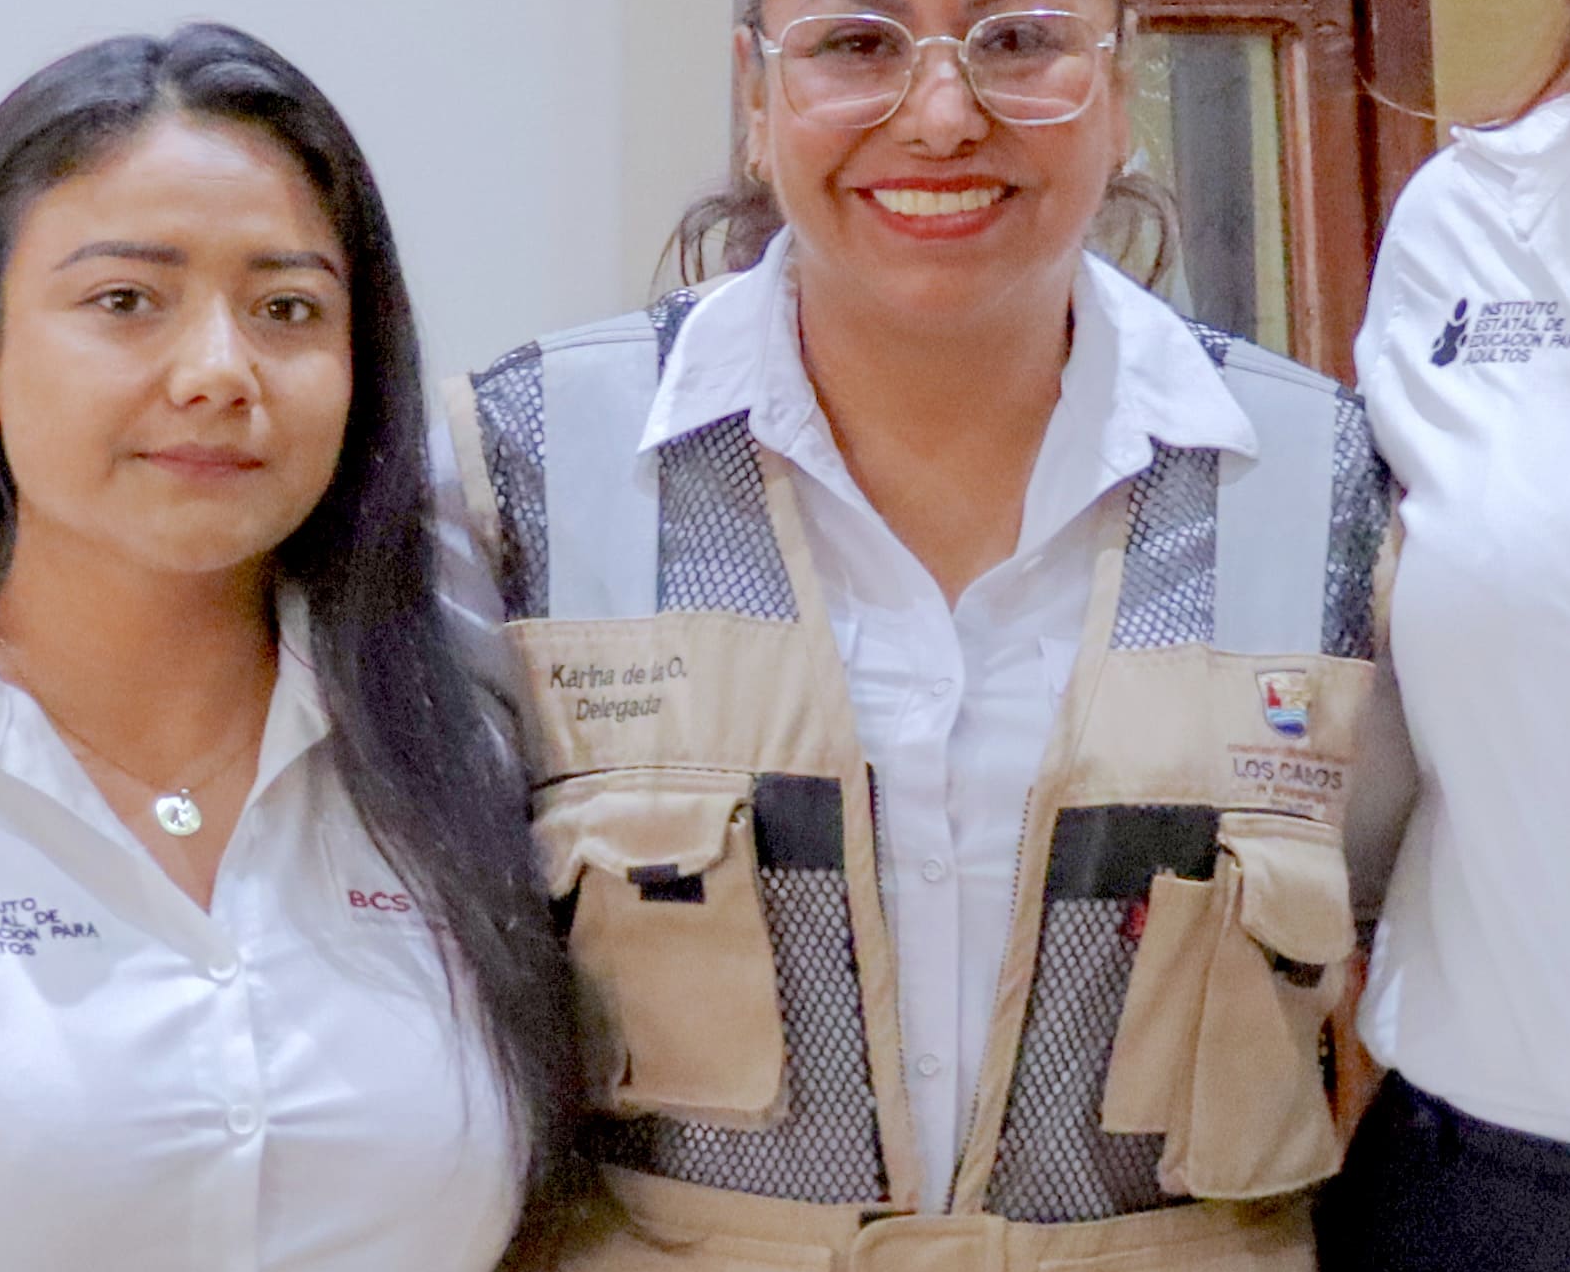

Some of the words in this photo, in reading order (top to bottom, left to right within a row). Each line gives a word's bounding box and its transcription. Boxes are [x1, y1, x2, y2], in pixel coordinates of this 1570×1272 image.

[1481, 301, 1558, 317] INSTITUTO
[1474, 318, 1538, 332] ESTATAL
[1544, 318, 1565, 331] DE
[1463, 349, 1531, 365] ADULTOS
[550, 664, 615, 689] Karina
[622, 663, 645, 685] de
[651, 662, 664, 684] la
[576, 693, 662, 722] Delegada
[1233, 757, 1274, 781] LOS
[34, 909, 61, 925] DE
[51, 923, 99, 939] PARA
